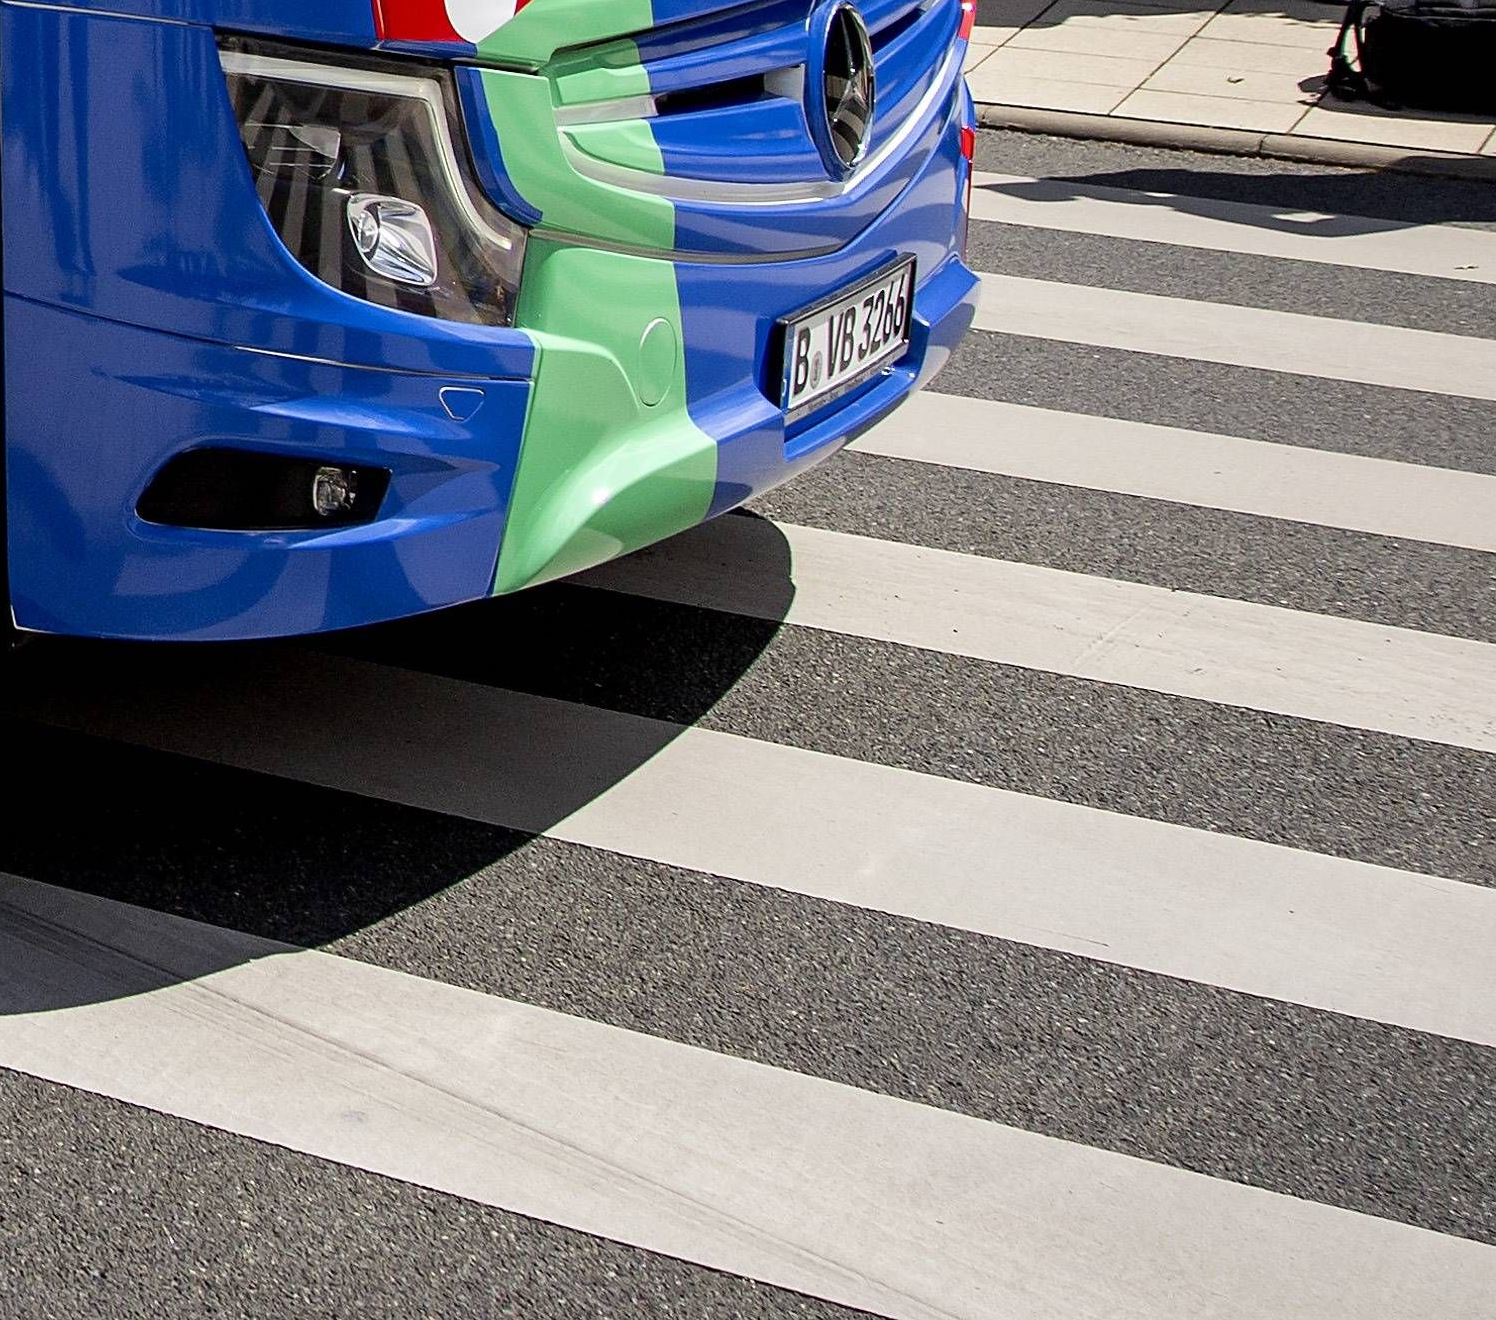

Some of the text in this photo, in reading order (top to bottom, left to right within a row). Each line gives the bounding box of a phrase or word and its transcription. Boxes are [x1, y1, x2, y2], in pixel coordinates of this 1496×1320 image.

[793, 327, 810, 395] B
[827, 306, 856, 379] VB
[858, 274, 905, 360] 3266
